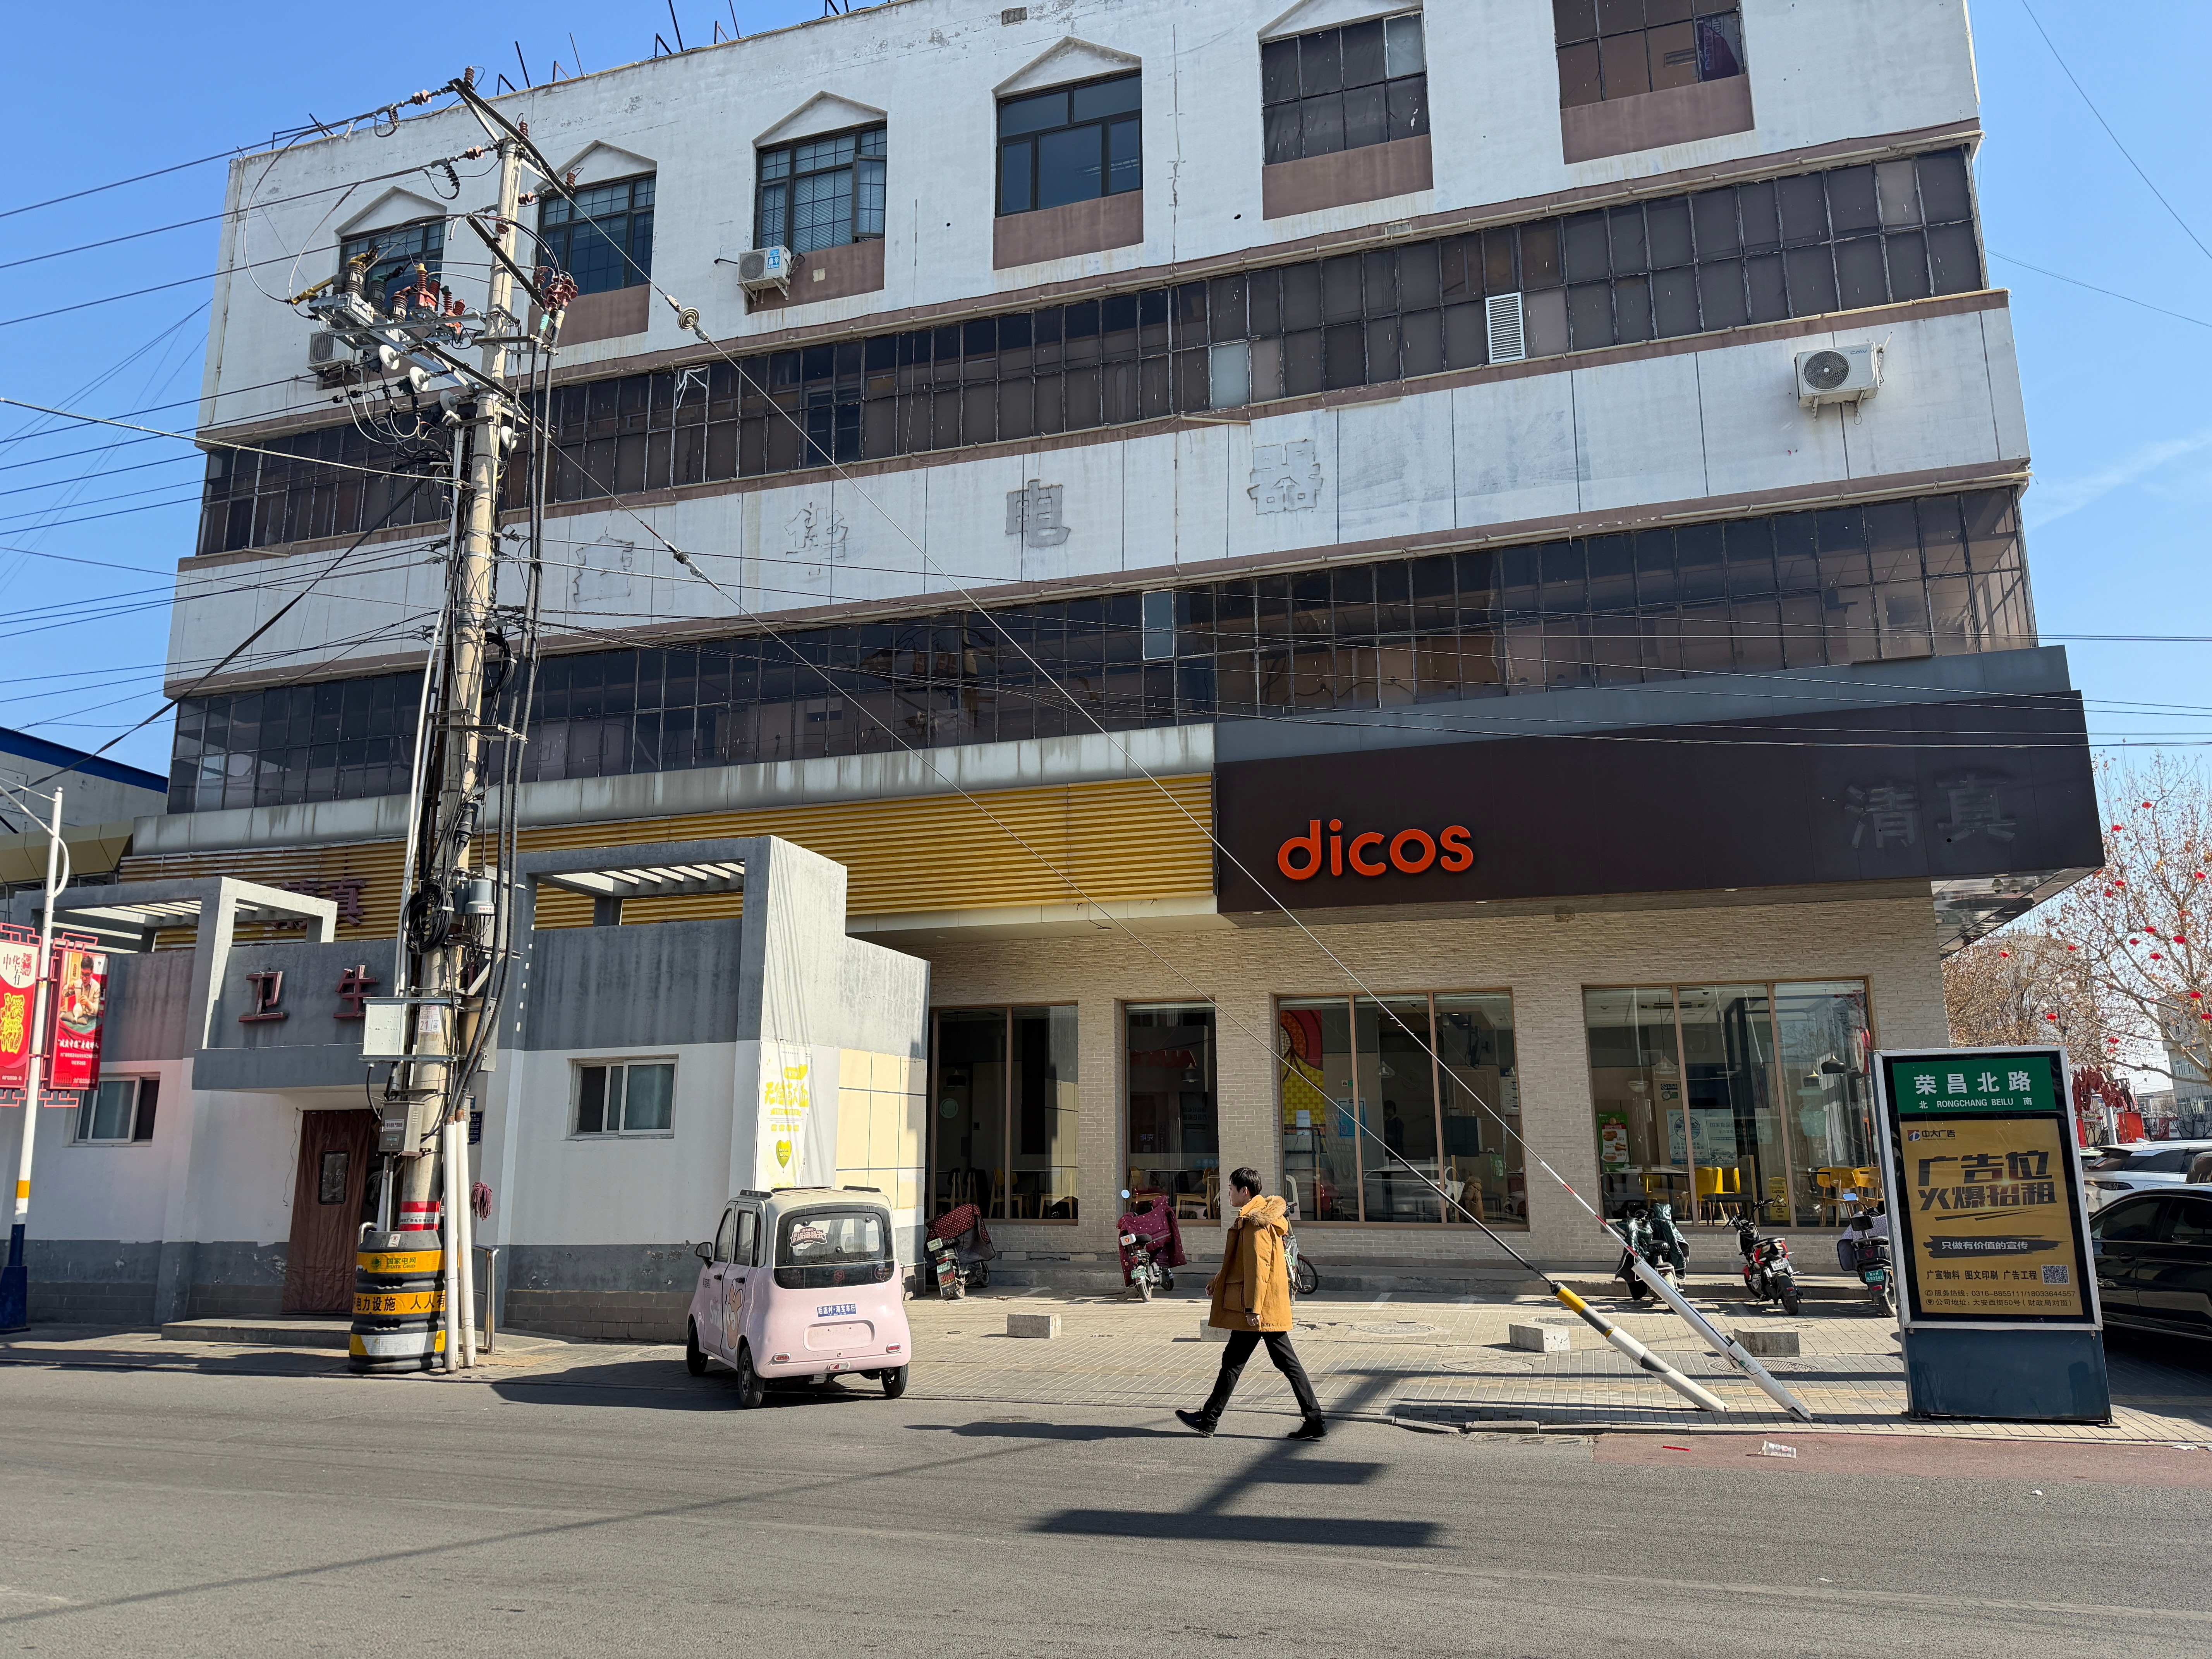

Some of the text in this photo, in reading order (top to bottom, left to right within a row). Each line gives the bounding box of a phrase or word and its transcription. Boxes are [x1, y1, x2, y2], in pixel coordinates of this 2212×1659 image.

[1844, 774, 2017, 848] 清真
[1278, 819, 1474, 880] dicos
[420, 1020, 428, 1030] 21
[1914, 1071, 2031, 1095] 荣昌北路
[1919, 1101, 1928, 1109] 北
[1937, 1098, 2014, 1108] RONGCHANG BEILU
[2023, 1097, 2032, 1106] 南
[1921, 1130, 1956, 1138] 中大广告
[1918, 1150, 2052, 1187] 广告位
[1917, 1181, 2057, 1211] 火爆招租
[1942, 1241, 2028, 1250] 只做有价值的宣传
[1927, 1270, 2038, 1280] 广宣物料 图文印刷 广告工程
[354, 1296, 396, 1312] 电力设施
